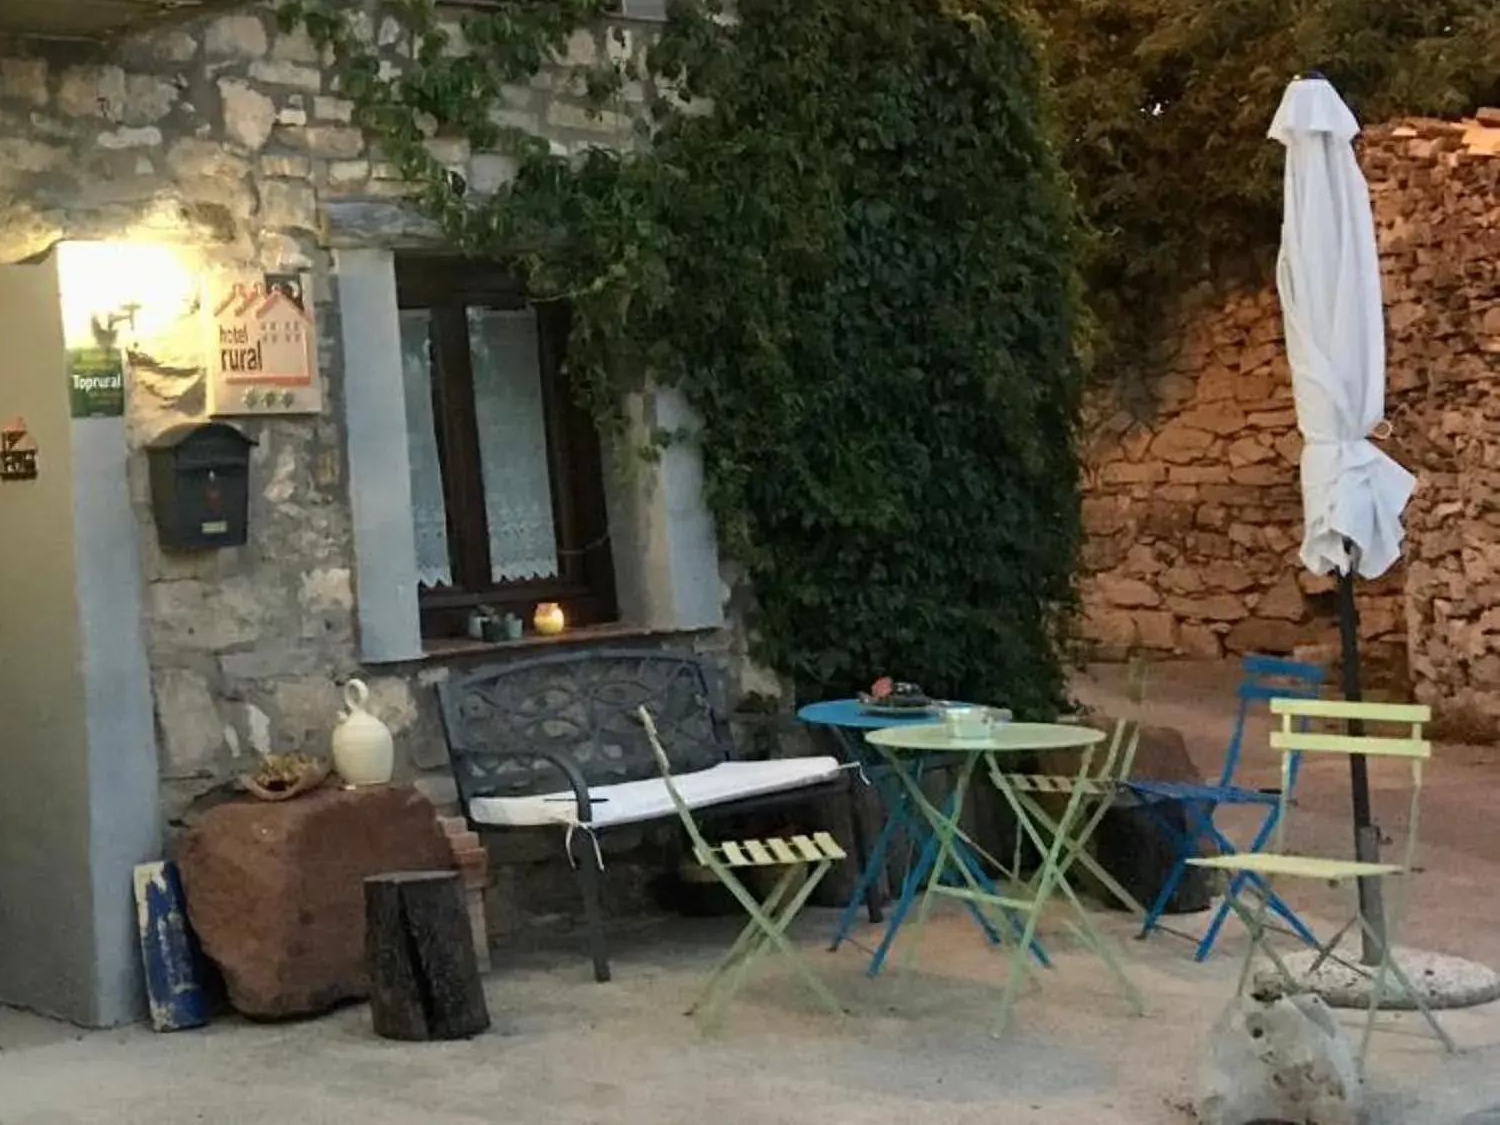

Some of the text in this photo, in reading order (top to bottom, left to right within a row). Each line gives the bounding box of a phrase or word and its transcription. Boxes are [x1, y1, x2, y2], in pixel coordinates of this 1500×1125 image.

[219, 322, 248, 344] hotel
[221, 340, 262, 371] rural
[72, 373, 122, 393] Toprural
